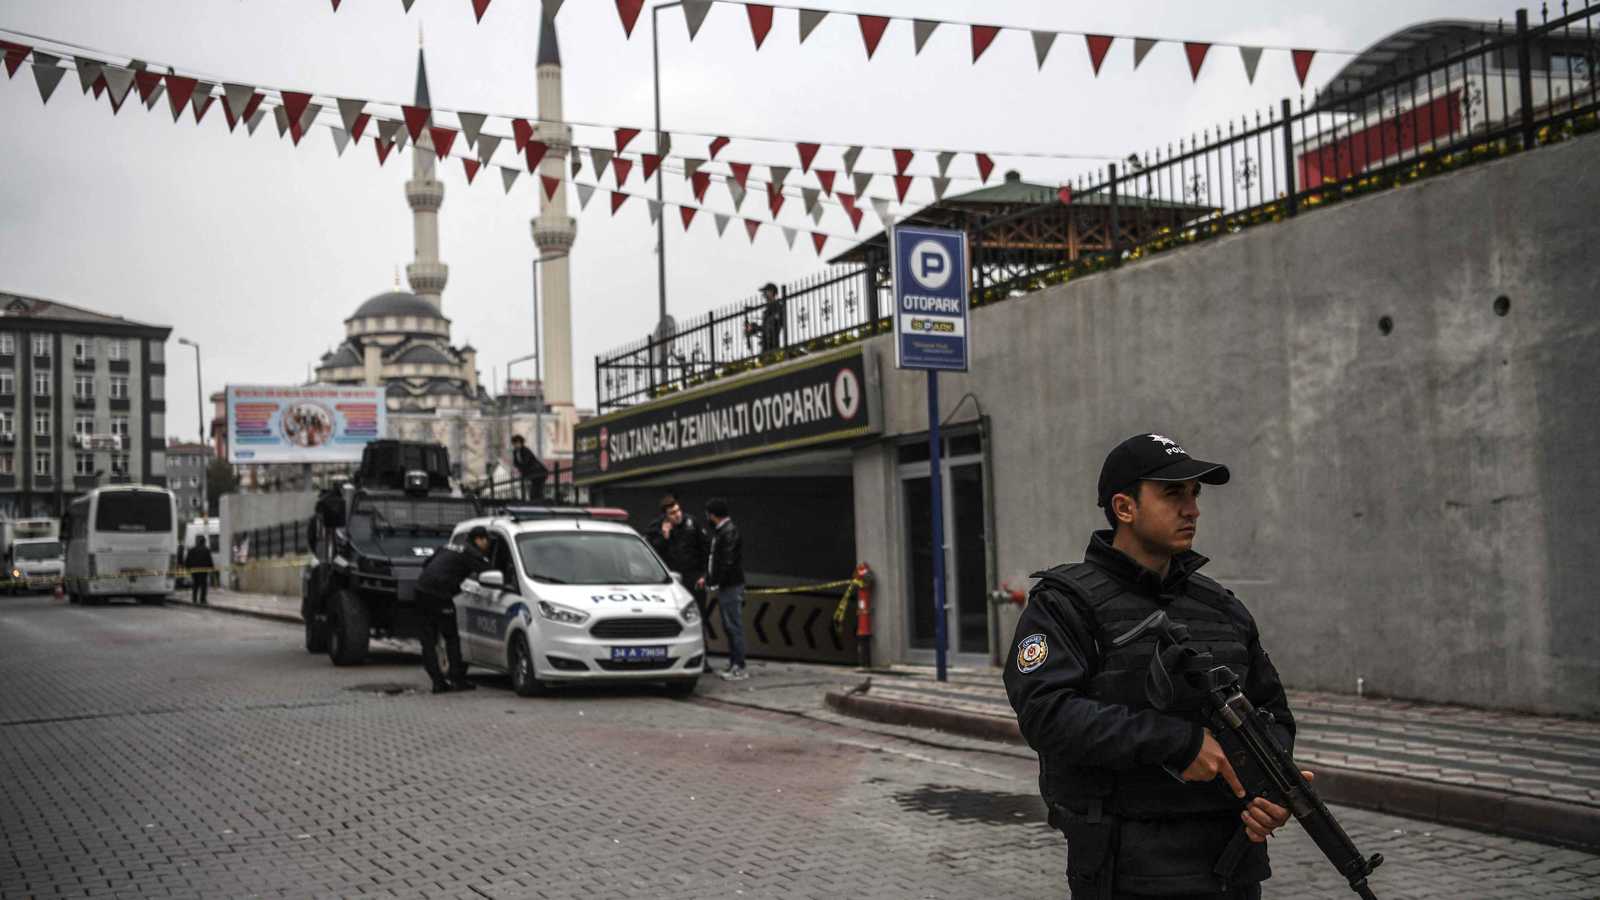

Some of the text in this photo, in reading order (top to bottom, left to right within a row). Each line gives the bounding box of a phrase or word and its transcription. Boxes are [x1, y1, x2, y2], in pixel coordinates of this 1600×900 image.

[920, 251, 944, 279] P
[903, 295, 960, 313] OTOPARK
[609, 382, 832, 463] SULTANGAZİ ZEMİNALTI OTOPARKI
